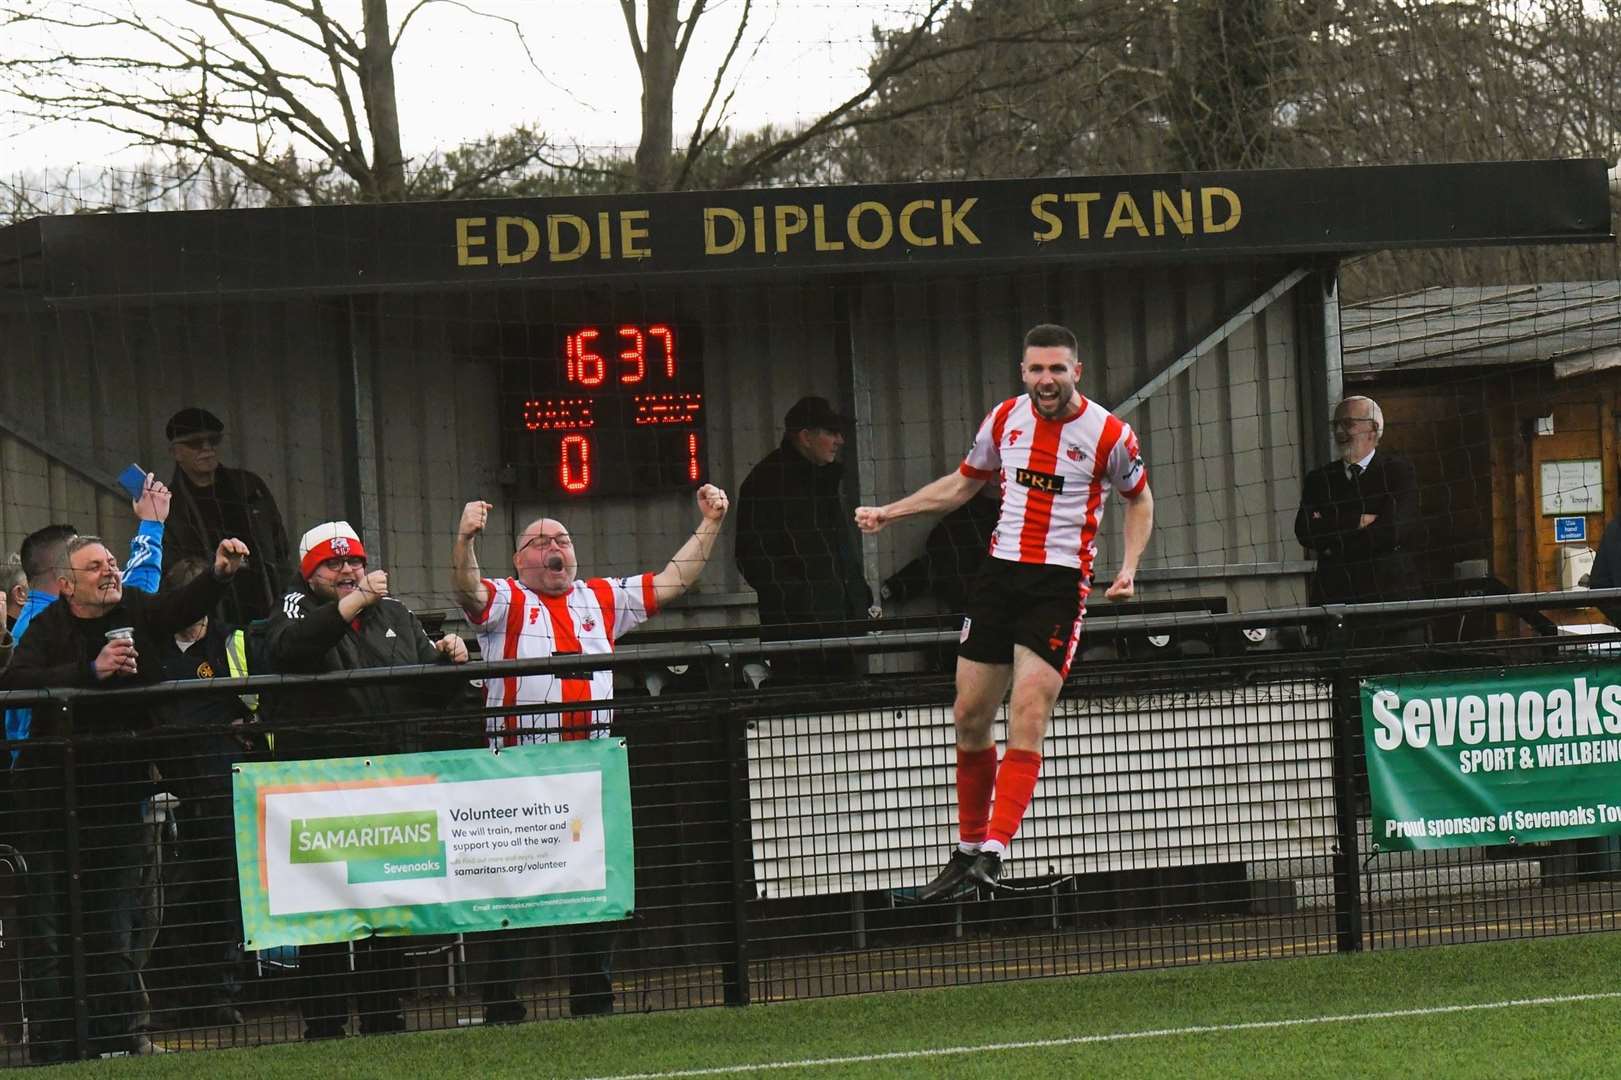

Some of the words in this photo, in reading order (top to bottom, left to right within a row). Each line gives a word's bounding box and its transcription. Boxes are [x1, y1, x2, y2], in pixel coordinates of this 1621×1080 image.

[455, 210, 652, 266] EDDIE
[703, 198, 982, 255] DIPLOCK
[1031, 187, 1242, 241] STAND
[566, 331, 604, 385] 16
[619, 327, 673, 382] 37
[1372, 677, 1621, 751] Sevenoaks
[1459, 748, 1515, 774] SPORT
[1519, 746, 1534, 769] &
[1536, 740, 1621, 768] WELLBEIN
[449, 807, 518, 822] Volunteer
[522, 803, 551, 817] with
[554, 803, 569, 814] us
[1386, 818, 1426, 838] Proud
[1428, 815, 1496, 837] sponsors
[1499, 811, 1513, 831] of
[1515, 807, 1596, 829] Sevenoaks
[298, 823, 431, 851] SAMARITANS
[452, 829, 467, 838] We
[469, 829, 485, 837] will
[487, 827, 512, 836] train,
[514, 824, 547, 834] mentor
[550, 821, 566, 831] and
[453, 839, 490, 852] support
[492, 838, 509, 850] you
[511, 836, 522, 845] all
[524, 834, 539, 844] the
[541, 836, 560, 845] way.
[383, 860, 440, 873] Sevenoaks
[454, 861, 567, 876] samaritans.org/volunteer
